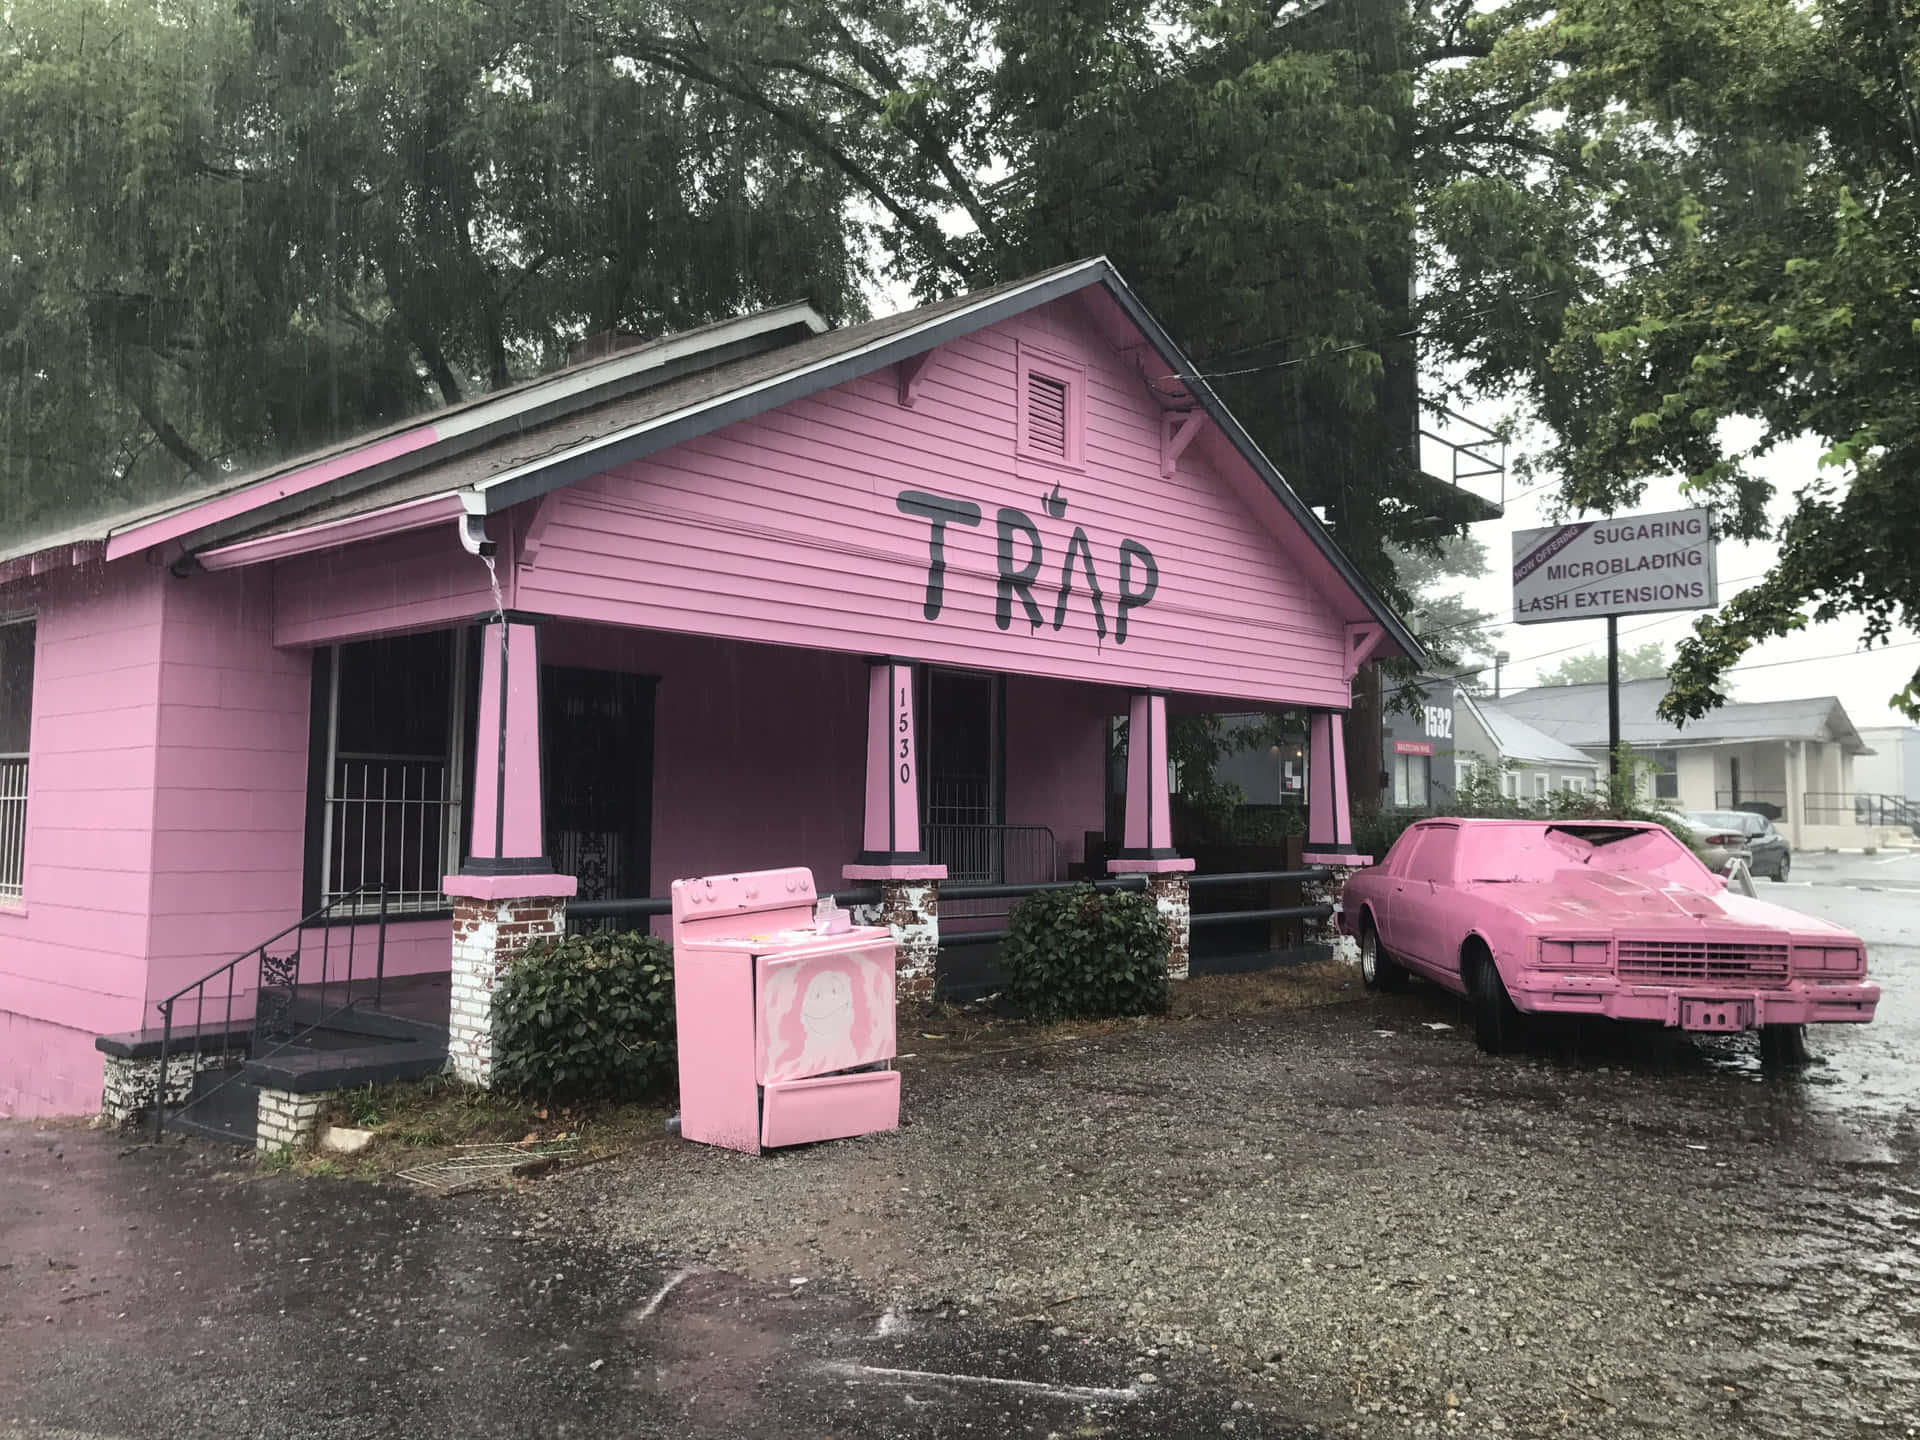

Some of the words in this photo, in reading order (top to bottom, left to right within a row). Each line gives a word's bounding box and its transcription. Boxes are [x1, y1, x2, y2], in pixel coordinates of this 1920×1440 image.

[1594, 519, 1701, 545] SUGARING
[895, 489, 1159, 645] TRAP
[1514, 559, 1535, 580] NOW
[1535, 526, 1578, 562] OFFERING
[1547, 550, 1702, 580] MICROBLADING
[1519, 596, 1568, 613] LASH
[1575, 582, 1704, 607] EXTENSIONS
[899, 688, 910, 784] 1530
[1424, 705, 1452, 738] 1532
